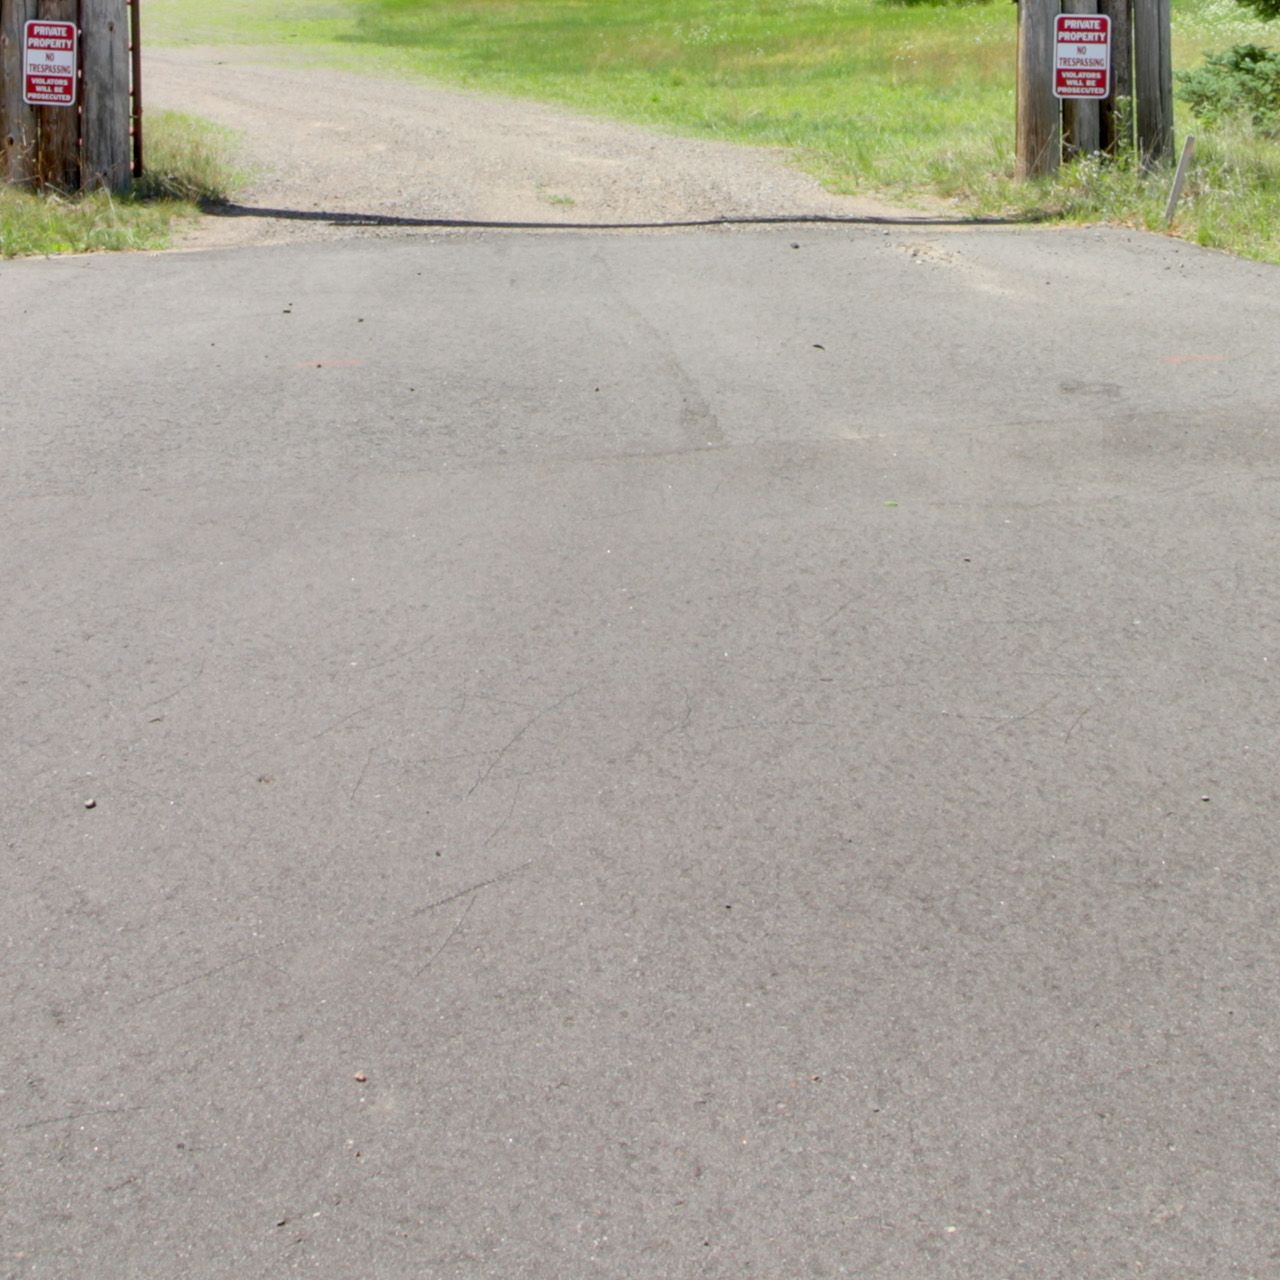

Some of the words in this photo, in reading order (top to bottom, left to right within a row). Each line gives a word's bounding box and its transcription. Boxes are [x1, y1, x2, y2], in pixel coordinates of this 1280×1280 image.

[1064, 19, 1101, 29] PRIVATE
[33, 25, 68, 37] PRIVATE
[1058, 31, 1106, 41] PROPERTY
[28, 37, 73, 49] PROPERTY
[1076, 46, 1087, 55] NO
[45, 53, 55, 61] NO
[1059, 57, 1104, 67] TRESPASSING
[29, 63, 71, 74] TRESPASSING
[1061, 71, 1101, 79] VIOLATORS
[31, 77, 68, 86] VIOLATORS
[27, 92, 71, 100] PROSECUTED
